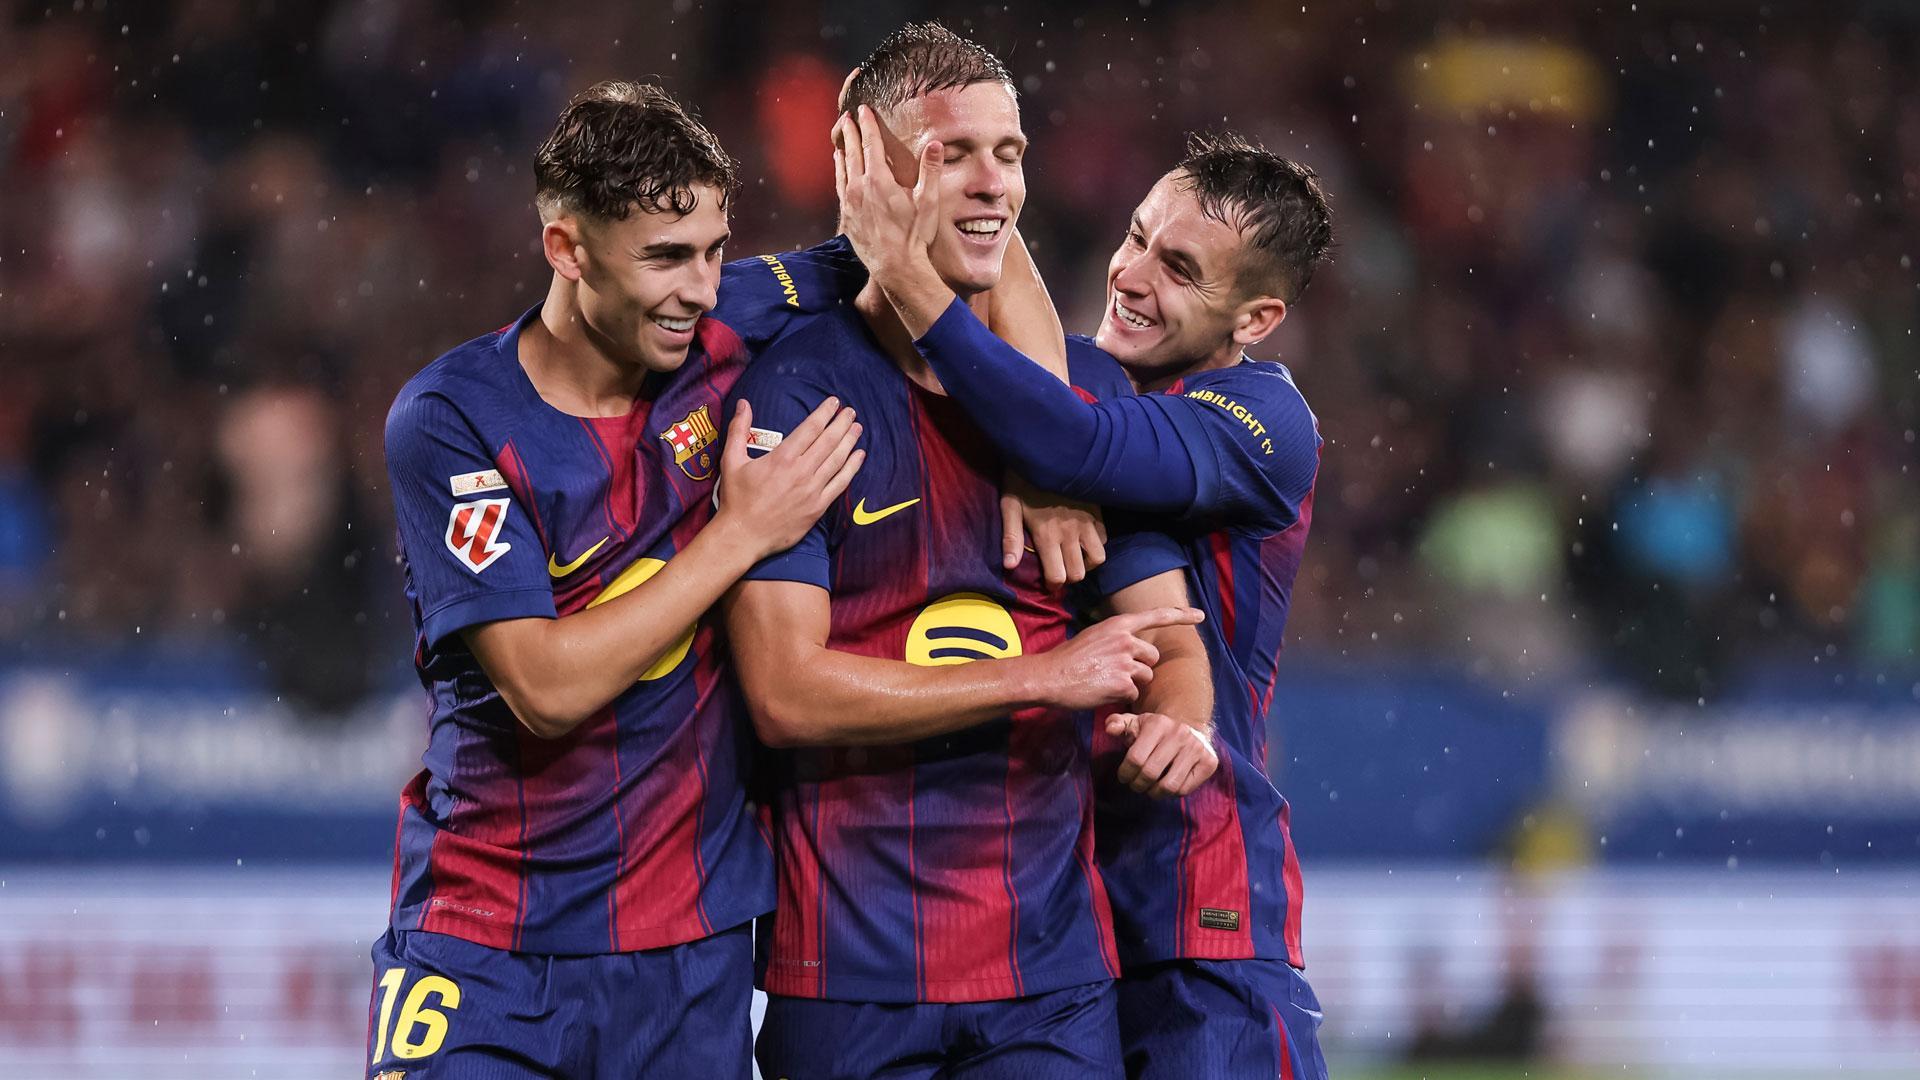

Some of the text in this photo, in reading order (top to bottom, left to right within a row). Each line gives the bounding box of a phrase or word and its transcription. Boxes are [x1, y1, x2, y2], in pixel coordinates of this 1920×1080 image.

[761, 254, 800, 307] AMBILIG
[1184, 390, 1274, 455] MBILIGHT tv
[372, 968, 461, 1065] 16
